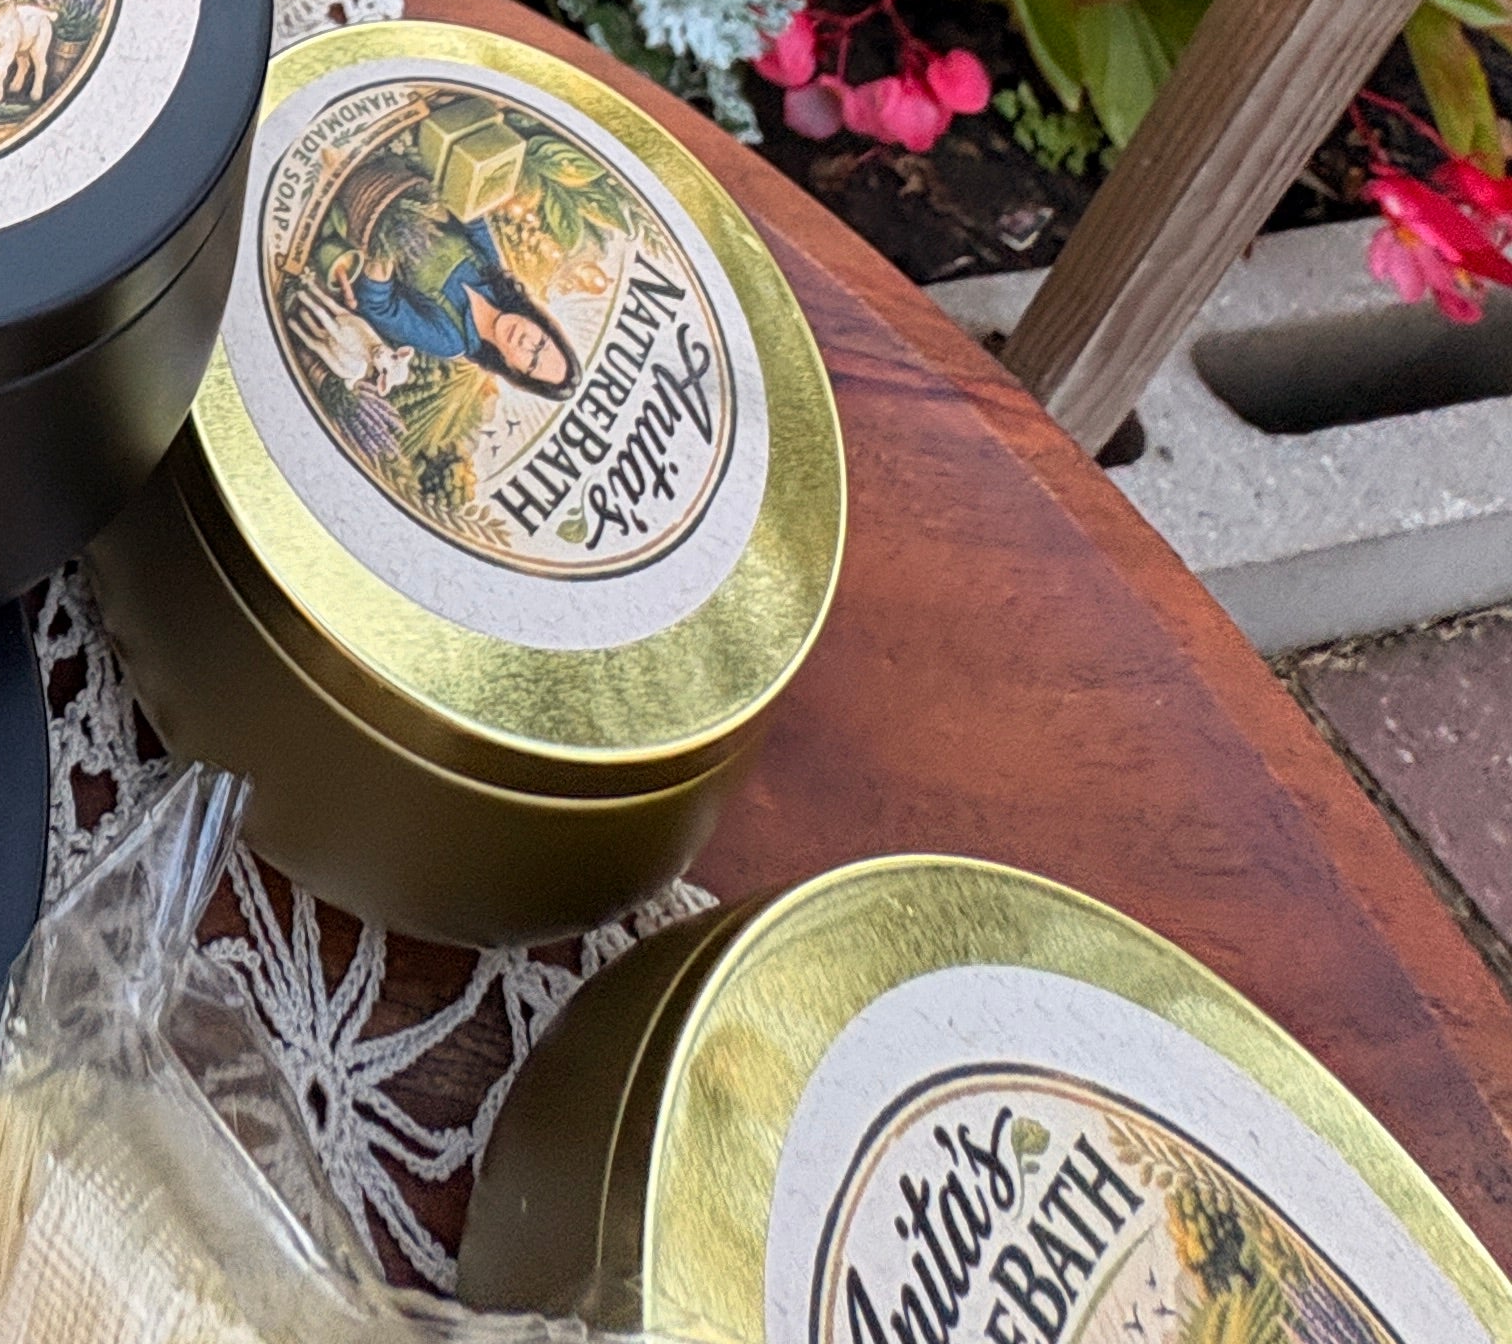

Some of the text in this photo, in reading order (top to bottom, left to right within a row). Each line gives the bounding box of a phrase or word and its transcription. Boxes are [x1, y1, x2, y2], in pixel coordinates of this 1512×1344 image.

[272, 168, 300, 232] SOAP
[292, 90, 399, 167] HANDMADE
[490, 250, 686, 537] NATUREBATH
[586, 323, 712, 550] Anita's
